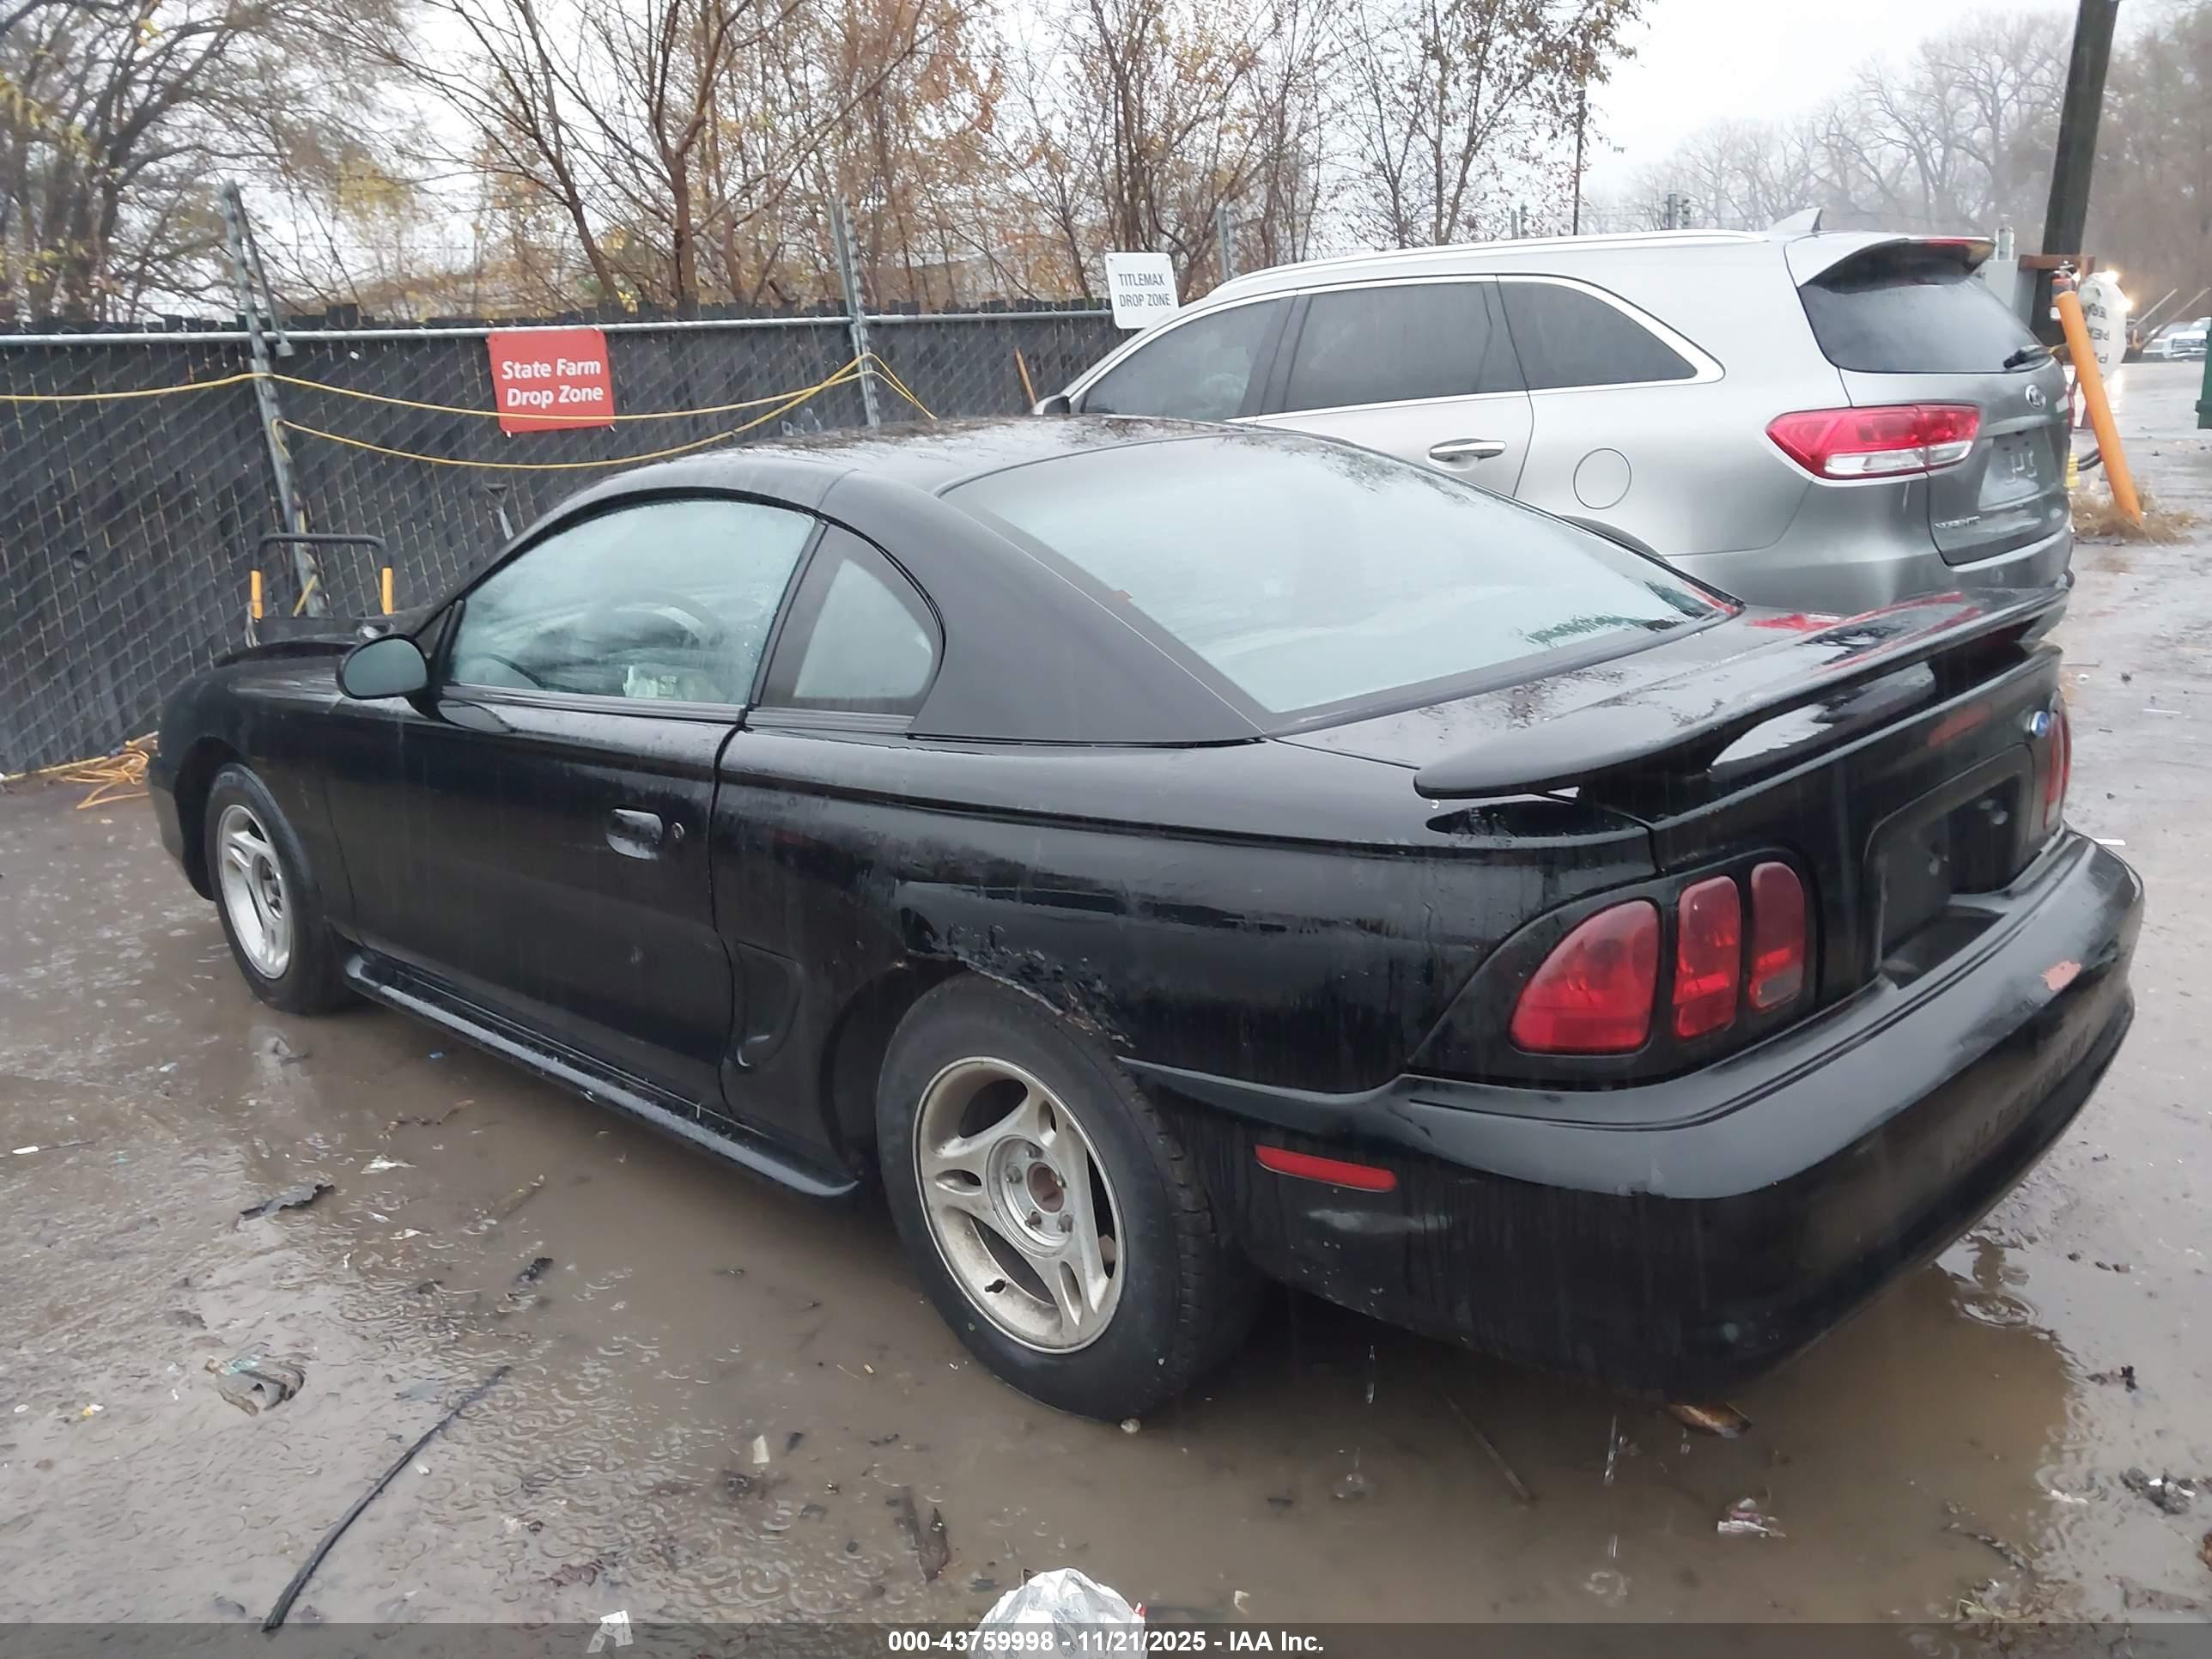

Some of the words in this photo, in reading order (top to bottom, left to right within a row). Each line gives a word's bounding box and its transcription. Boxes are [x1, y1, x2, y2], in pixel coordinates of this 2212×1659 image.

[1118, 273, 1165, 287] TITLEMAX
[1119, 294, 1145, 307] DROP
[1146, 293, 1171, 307] ZONE
[501, 360, 552, 380] State
[556, 357, 601, 377] Farm
[507, 387, 554, 410] Drop
[558, 385, 604, 404] Zone
